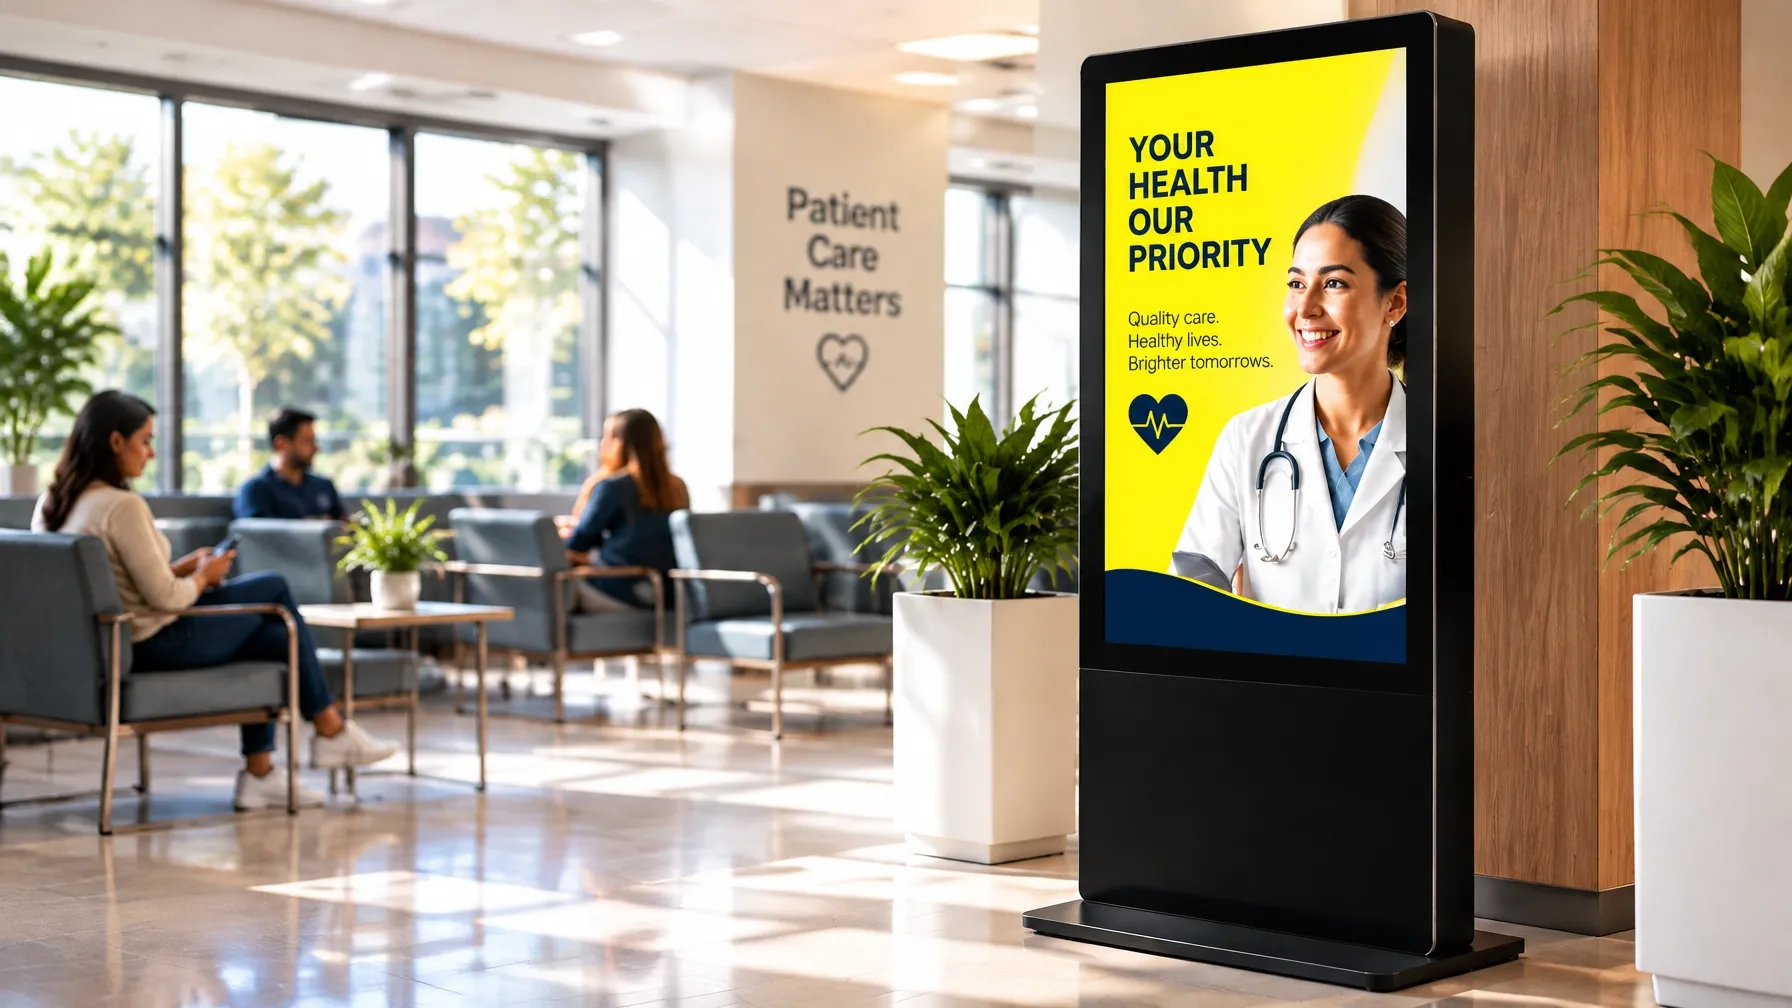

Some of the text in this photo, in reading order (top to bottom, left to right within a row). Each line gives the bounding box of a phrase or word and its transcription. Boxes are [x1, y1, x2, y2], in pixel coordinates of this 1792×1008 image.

[1129, 130, 1214, 163] YOUR
[1129, 164, 1248, 200] HEALTH
[786, 186, 901, 231] Patient
[1128, 205, 1193, 236] OUR
[807, 234, 879, 272] Care
[1129, 237, 1272, 273] PRIORITY
[783, 276, 902, 318] Matters
[1128, 310, 1220, 329] Quality care.
[1128, 331, 1223, 351] Healthy lives.
[1128, 355, 1274, 375] Brighter tomorrows.
